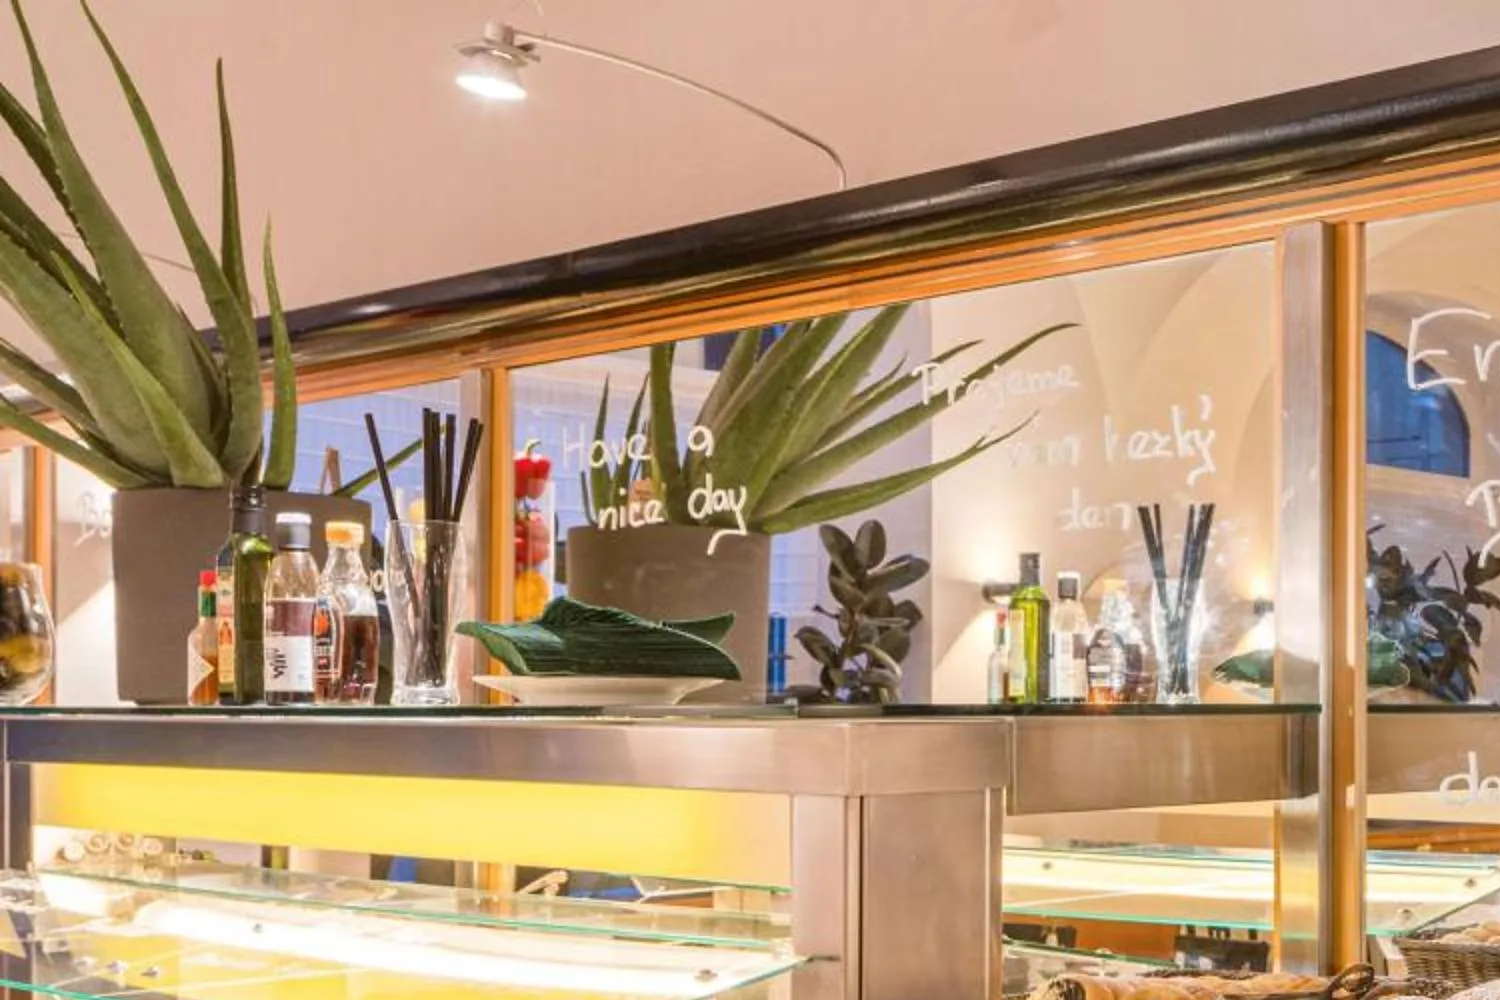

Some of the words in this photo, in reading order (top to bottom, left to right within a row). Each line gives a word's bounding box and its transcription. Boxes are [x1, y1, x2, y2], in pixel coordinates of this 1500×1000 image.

[562, 422, 653, 474] Have
[687, 425, 714, 458] a
[598, 486, 665, 531] nice
[687, 472, 747, 556] day
